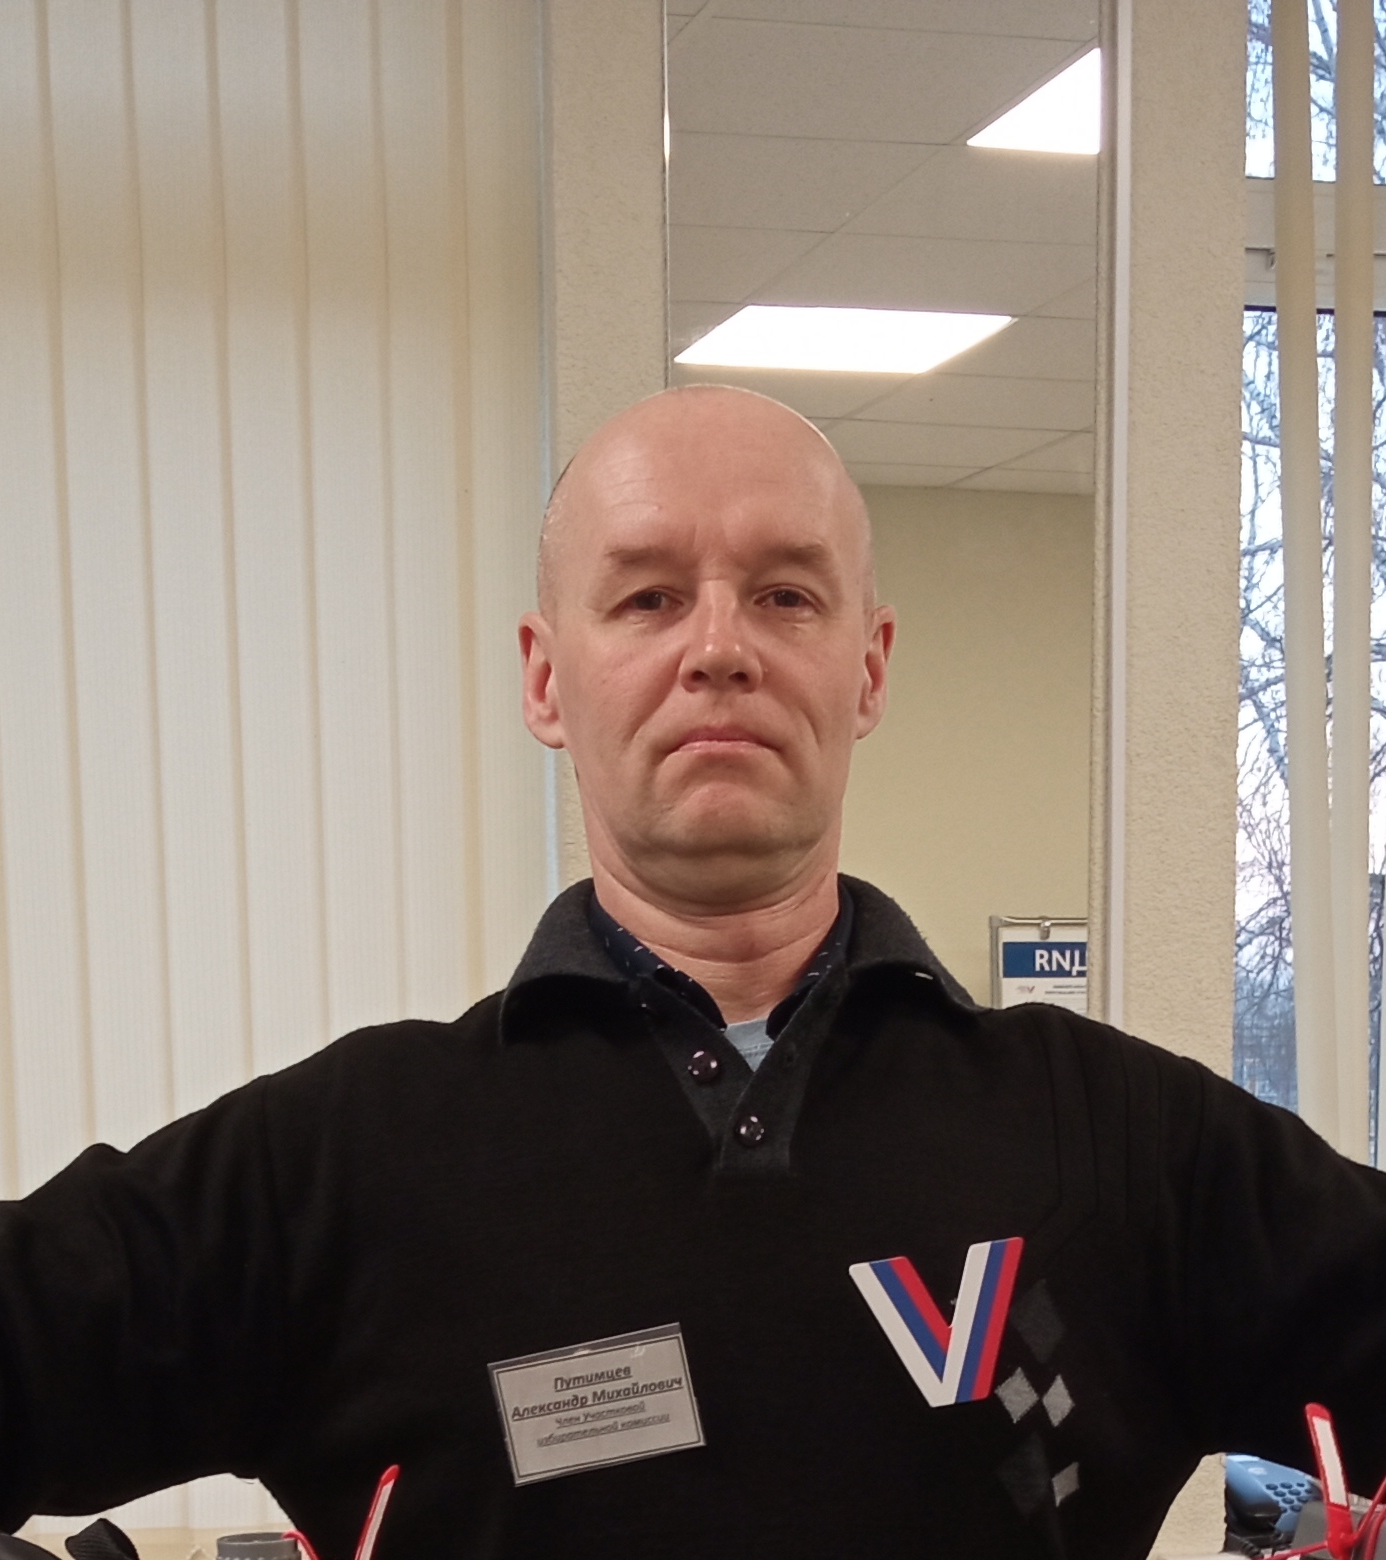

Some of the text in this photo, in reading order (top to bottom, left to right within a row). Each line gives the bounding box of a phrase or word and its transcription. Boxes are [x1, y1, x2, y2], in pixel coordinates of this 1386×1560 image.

[554, 1366, 632, 1391] Путимцев
[512, 1377, 683, 1420] Александр Михайлович
[537, 1413, 670, 1446] избирательной комиссии
[555, 1401, 645, 1428] Член Участковой
